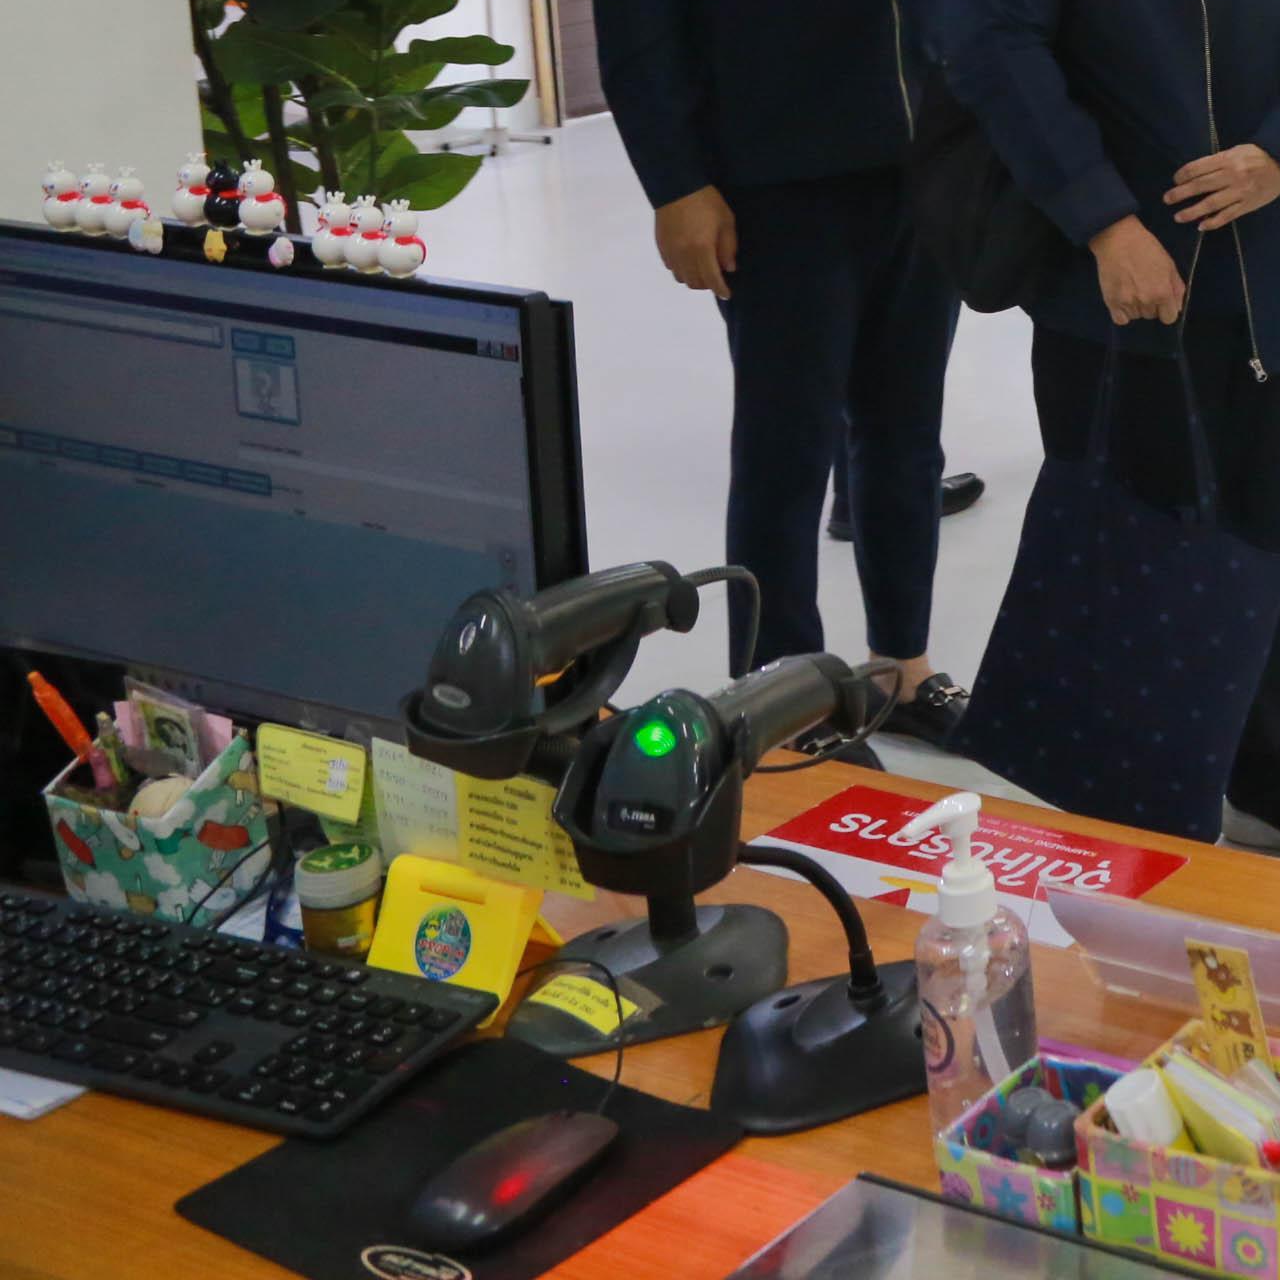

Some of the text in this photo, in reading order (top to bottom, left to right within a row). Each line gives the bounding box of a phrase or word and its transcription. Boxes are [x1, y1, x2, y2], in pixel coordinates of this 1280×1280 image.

[828, 811, 1113, 893] จุดใหบริการ
